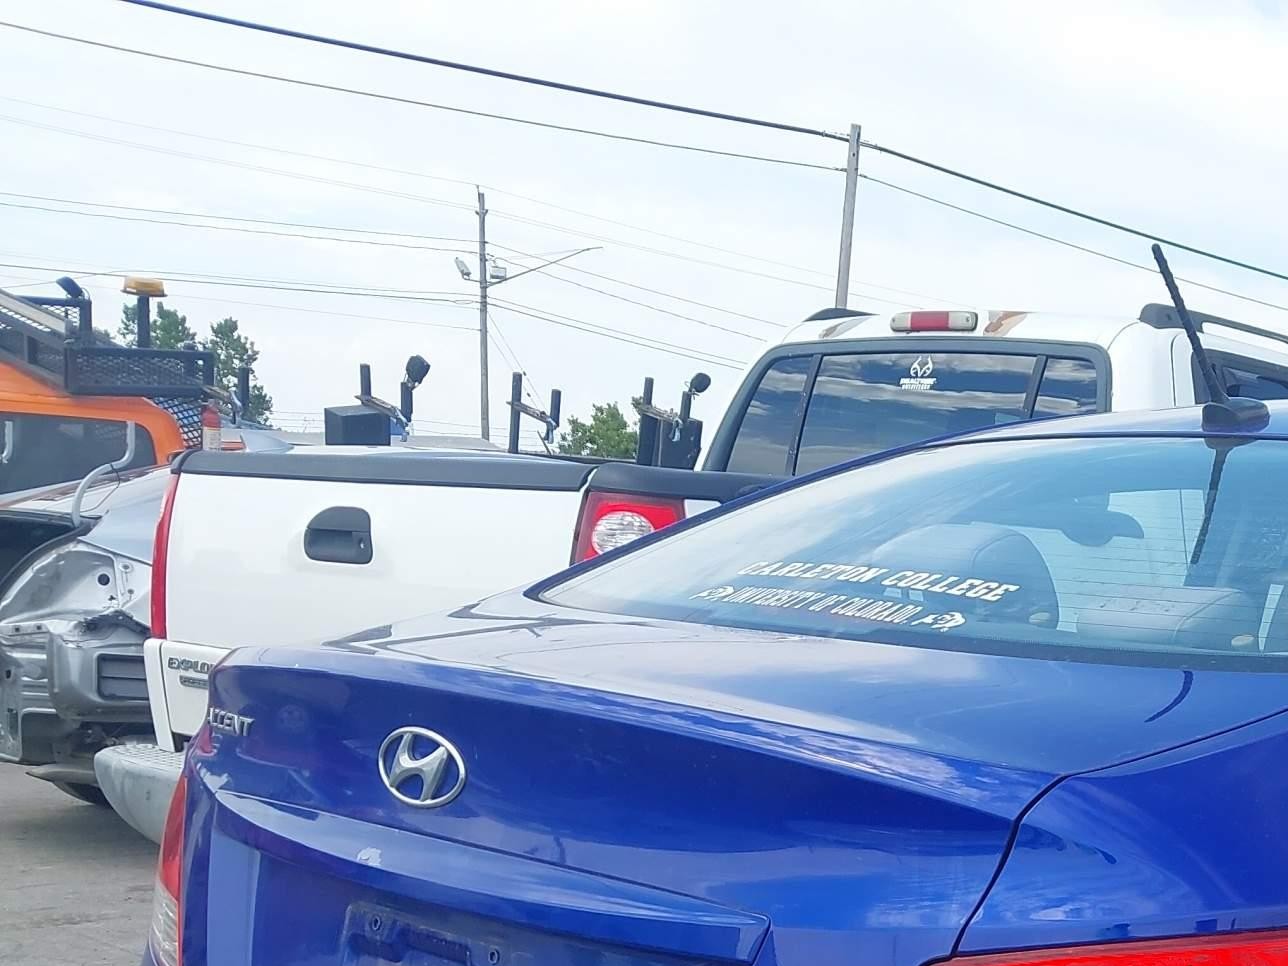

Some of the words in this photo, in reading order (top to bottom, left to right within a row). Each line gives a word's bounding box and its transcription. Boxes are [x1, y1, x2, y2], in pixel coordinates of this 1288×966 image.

[737, 561, 889, 583] CARLETON
[881, 570, 1020, 601] COLLEGE
[722, 586, 826, 609] UNIVERSITY
[808, 595, 848, 612] OF
[168, 657, 213, 674] EXPLO
